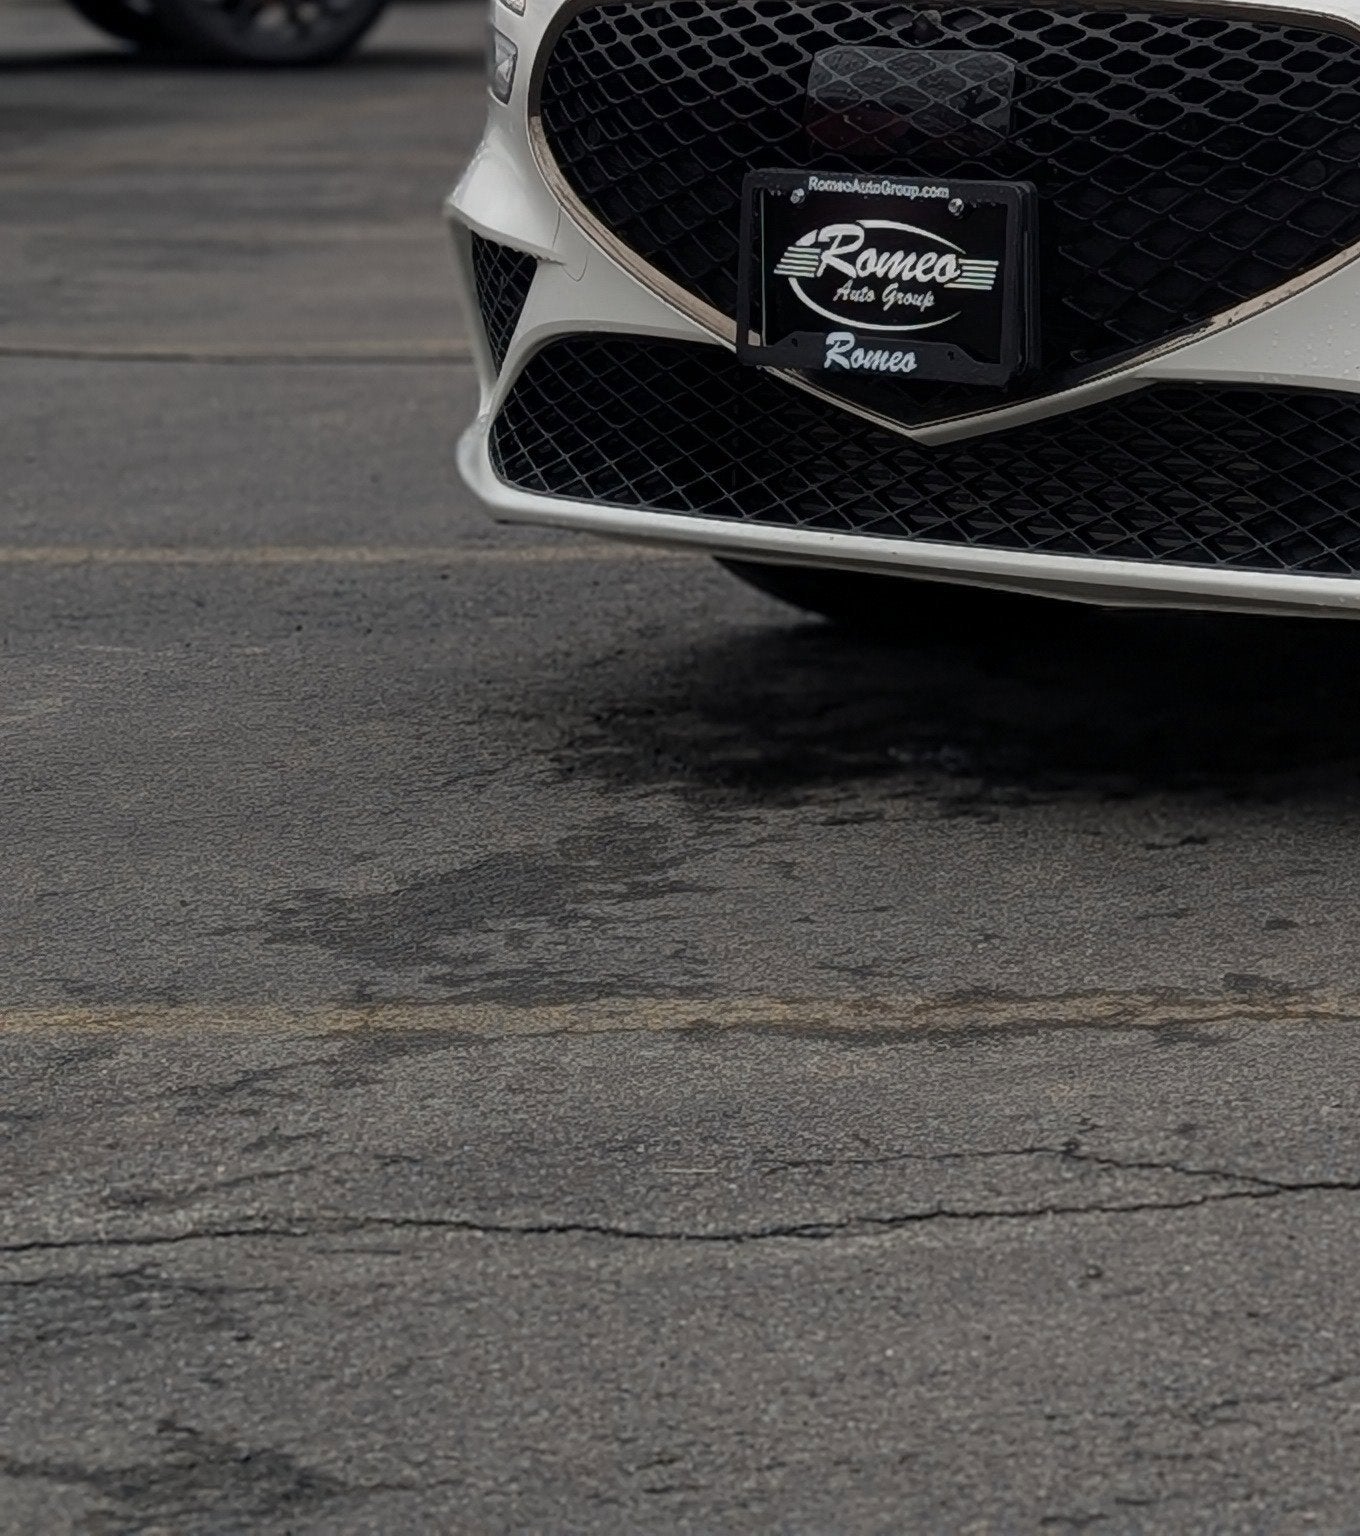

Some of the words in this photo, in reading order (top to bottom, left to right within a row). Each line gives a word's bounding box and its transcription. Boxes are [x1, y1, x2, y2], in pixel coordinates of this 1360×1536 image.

[808, 175, 950, 200] RomeoAutoGroup.com
[816, 223, 961, 283] Romeo
[833, 279, 876, 303] Auto
[881, 282, 935, 312] Group
[823, 331, 918, 373] Romeo
